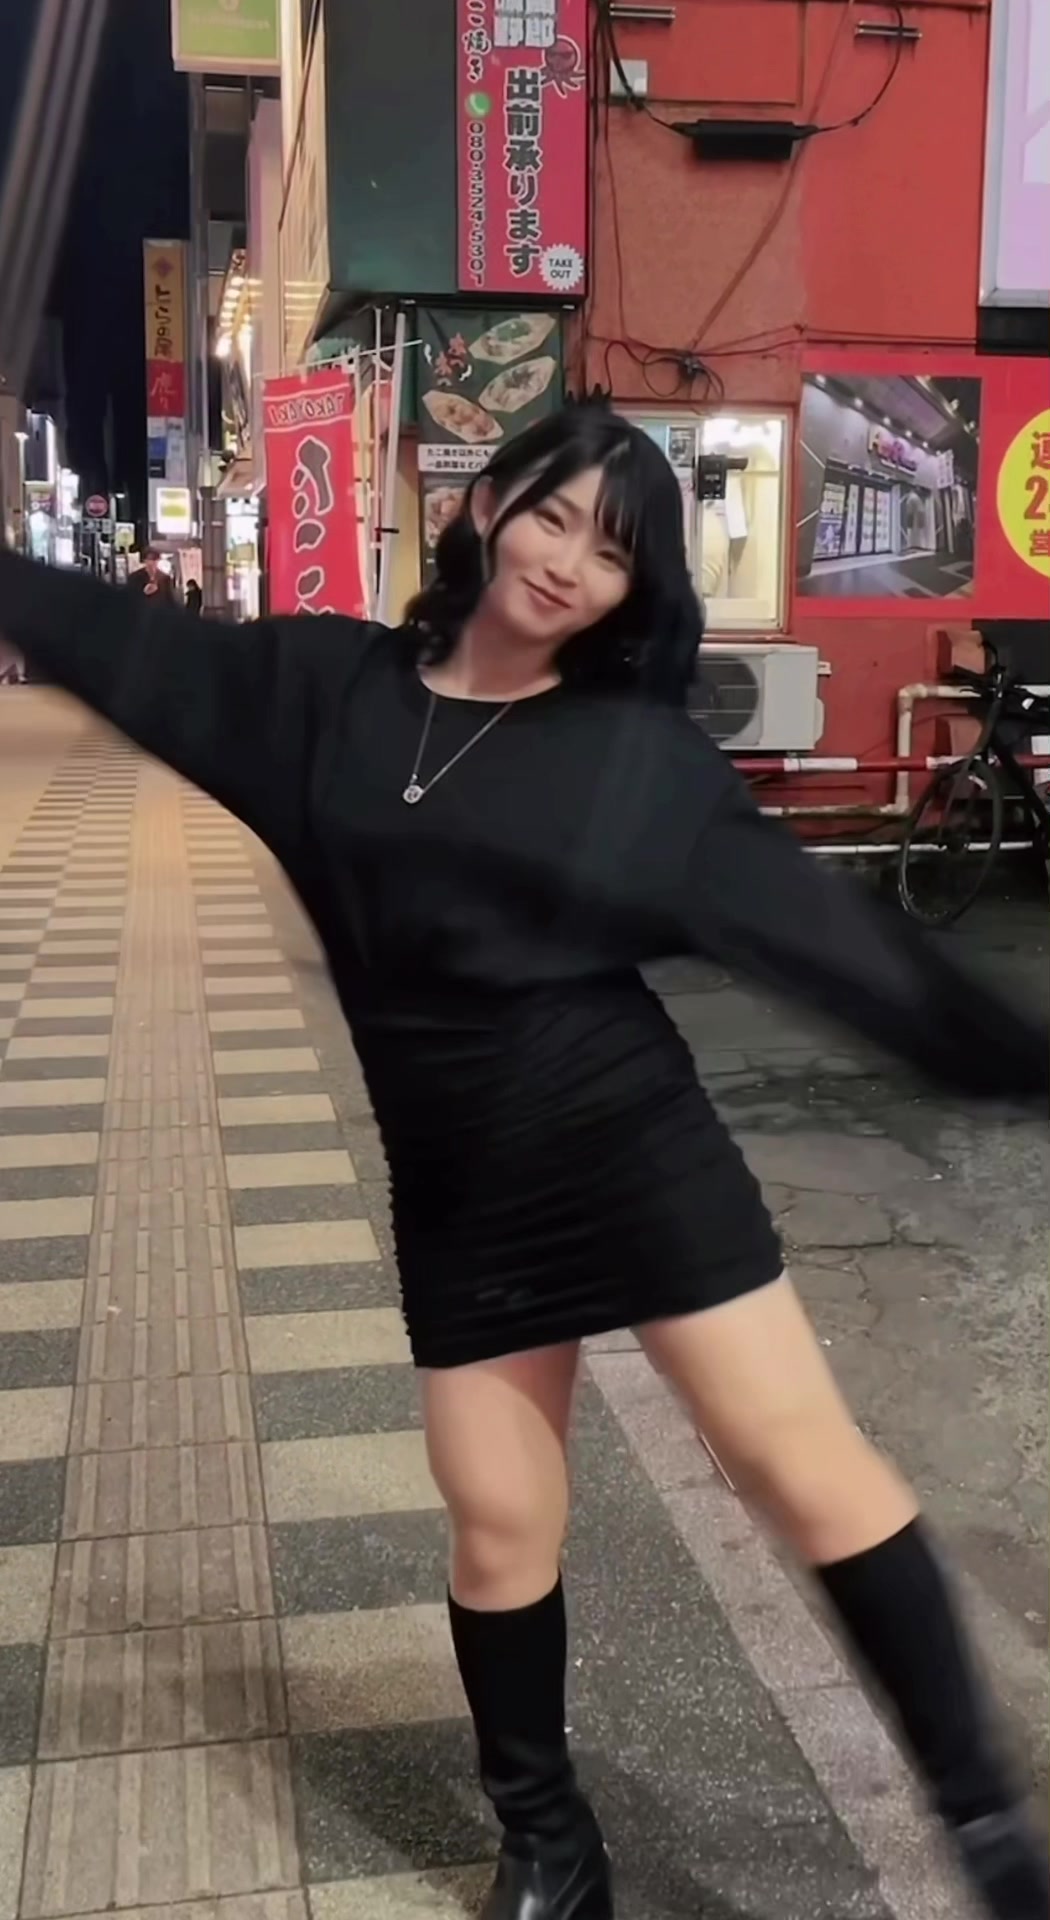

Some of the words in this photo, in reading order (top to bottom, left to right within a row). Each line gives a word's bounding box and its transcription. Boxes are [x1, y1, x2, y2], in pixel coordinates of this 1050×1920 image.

[503, 67, 543, 277] 出前承ります
[549, 258, 573, 268] TAKE
[550, 269, 571, 279] OUT
